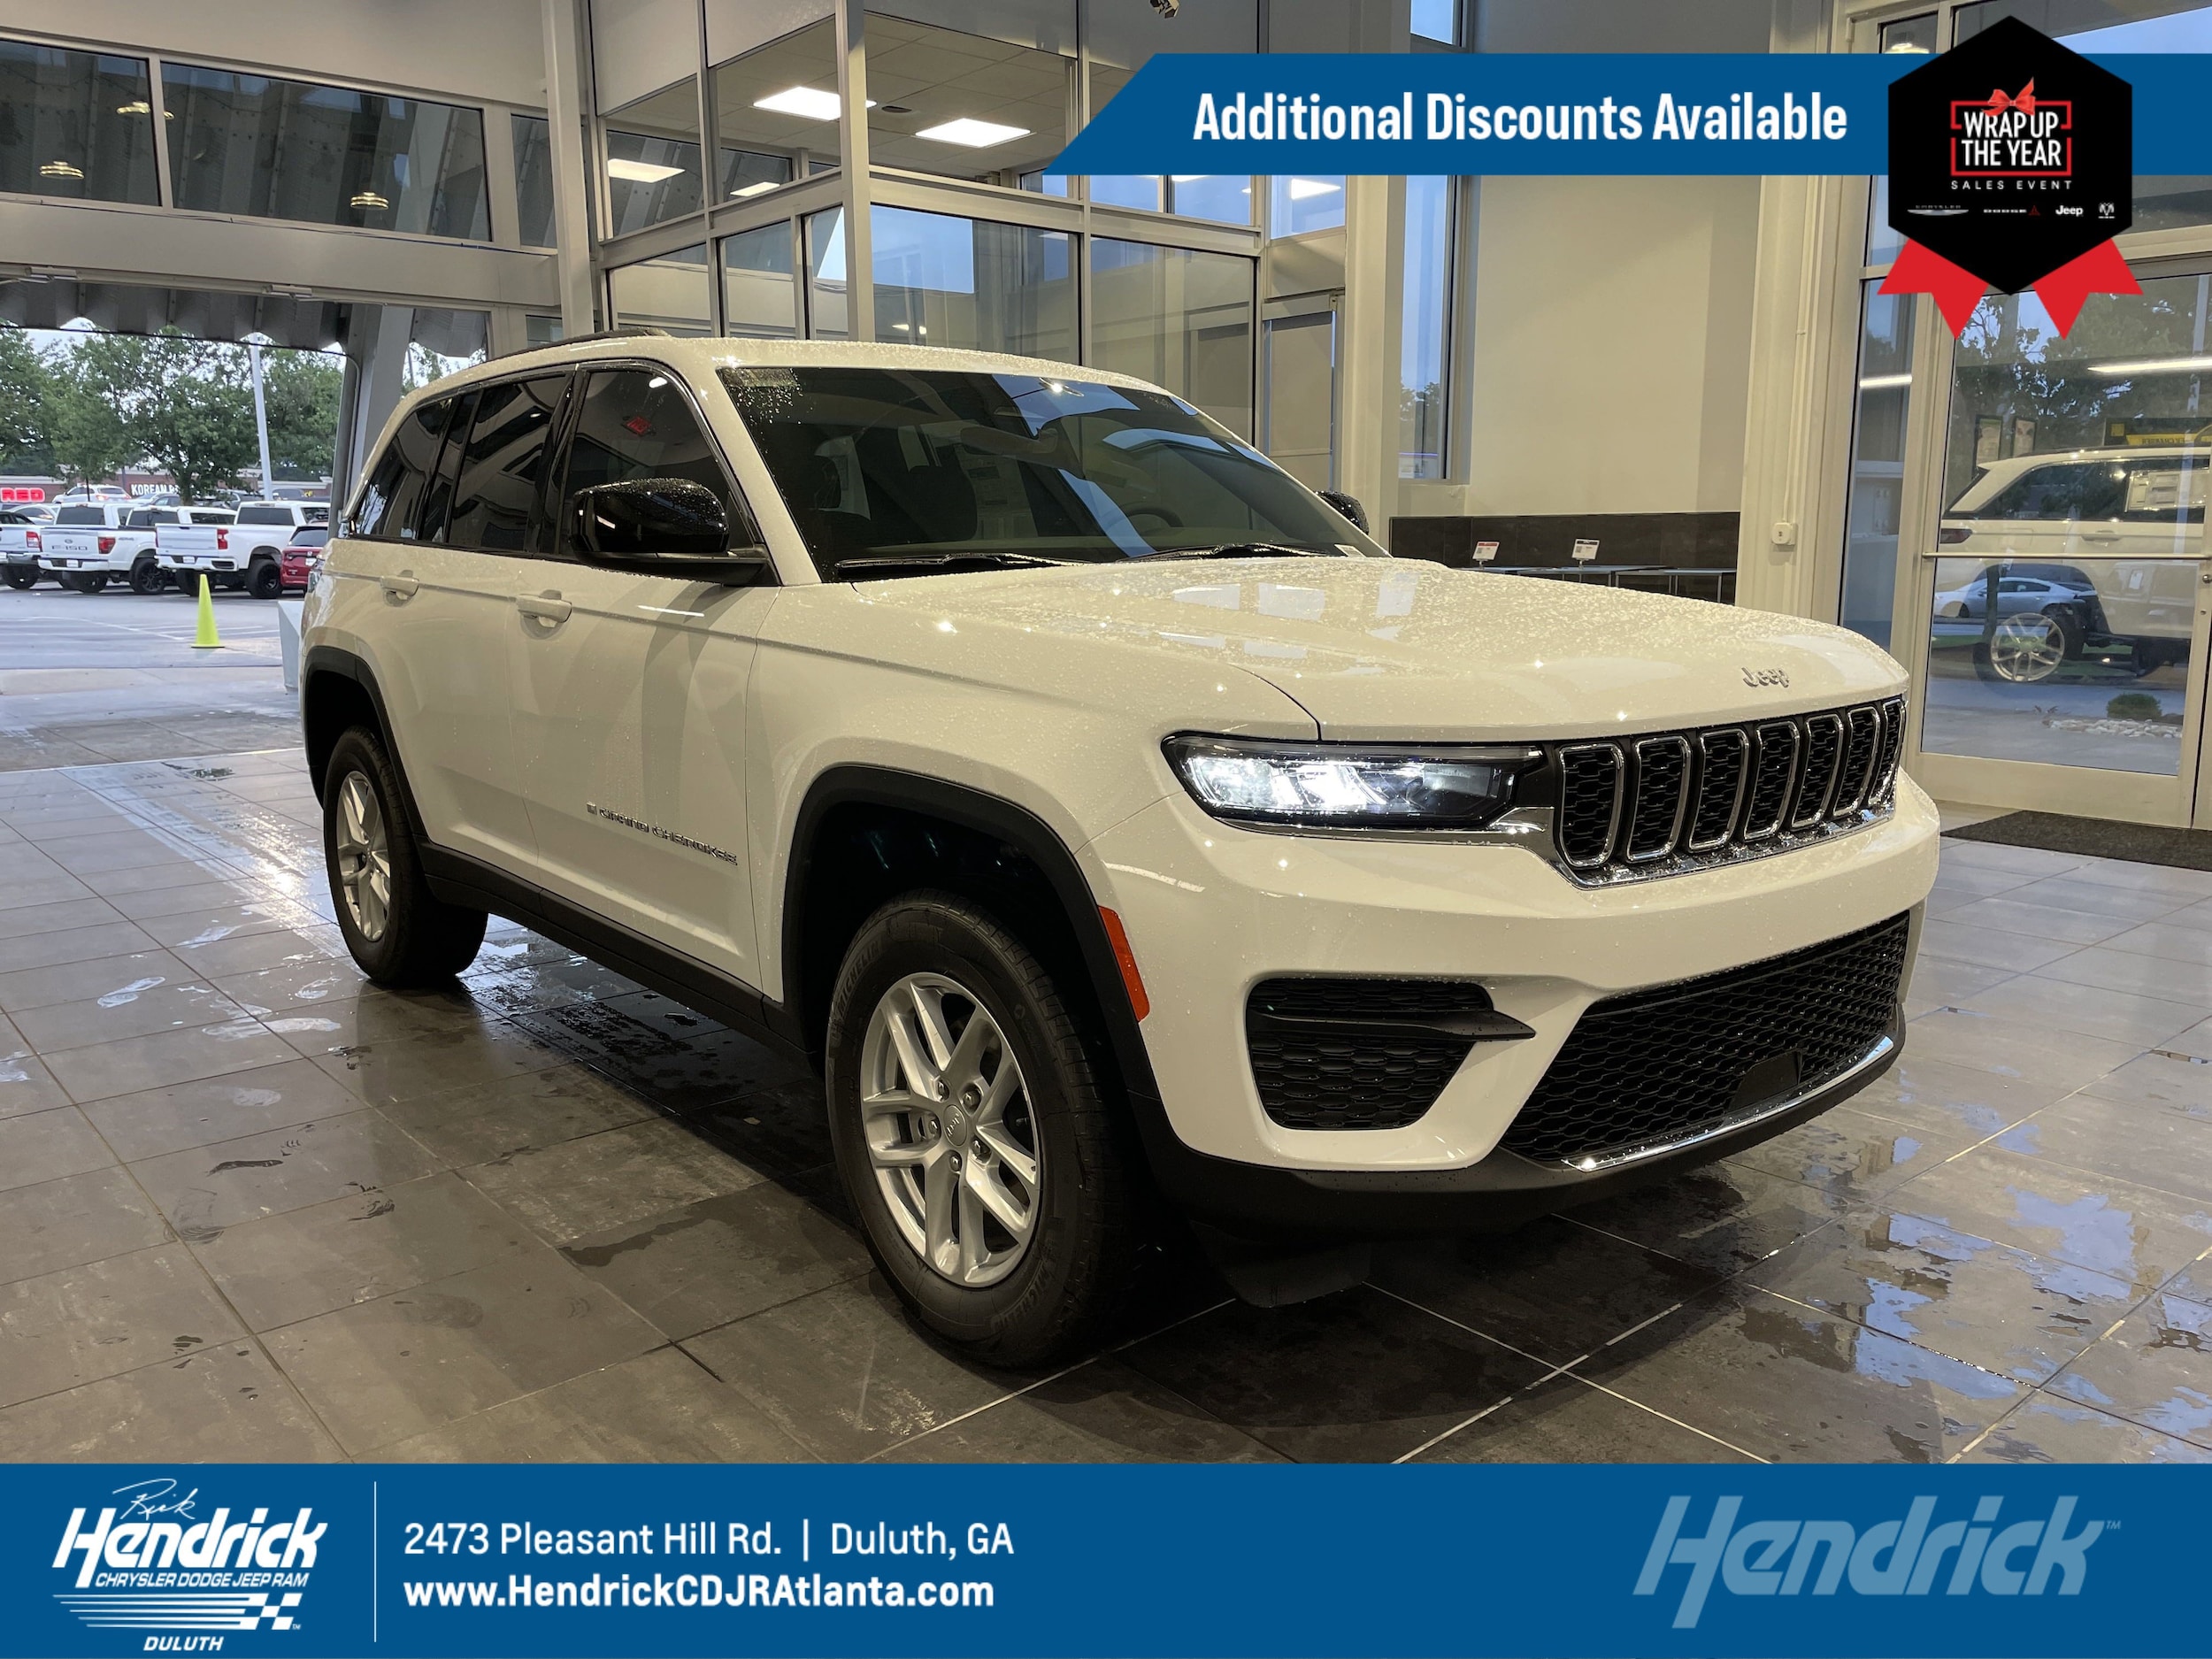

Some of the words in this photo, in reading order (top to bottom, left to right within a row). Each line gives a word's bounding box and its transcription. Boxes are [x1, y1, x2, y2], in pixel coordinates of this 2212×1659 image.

[131, 483, 167, 496] KOREAN
[1742, 665, 1790, 688] Jeep
[599, 806, 650, 833] GRAND
[651, 825, 738, 867] CHEROKEE
